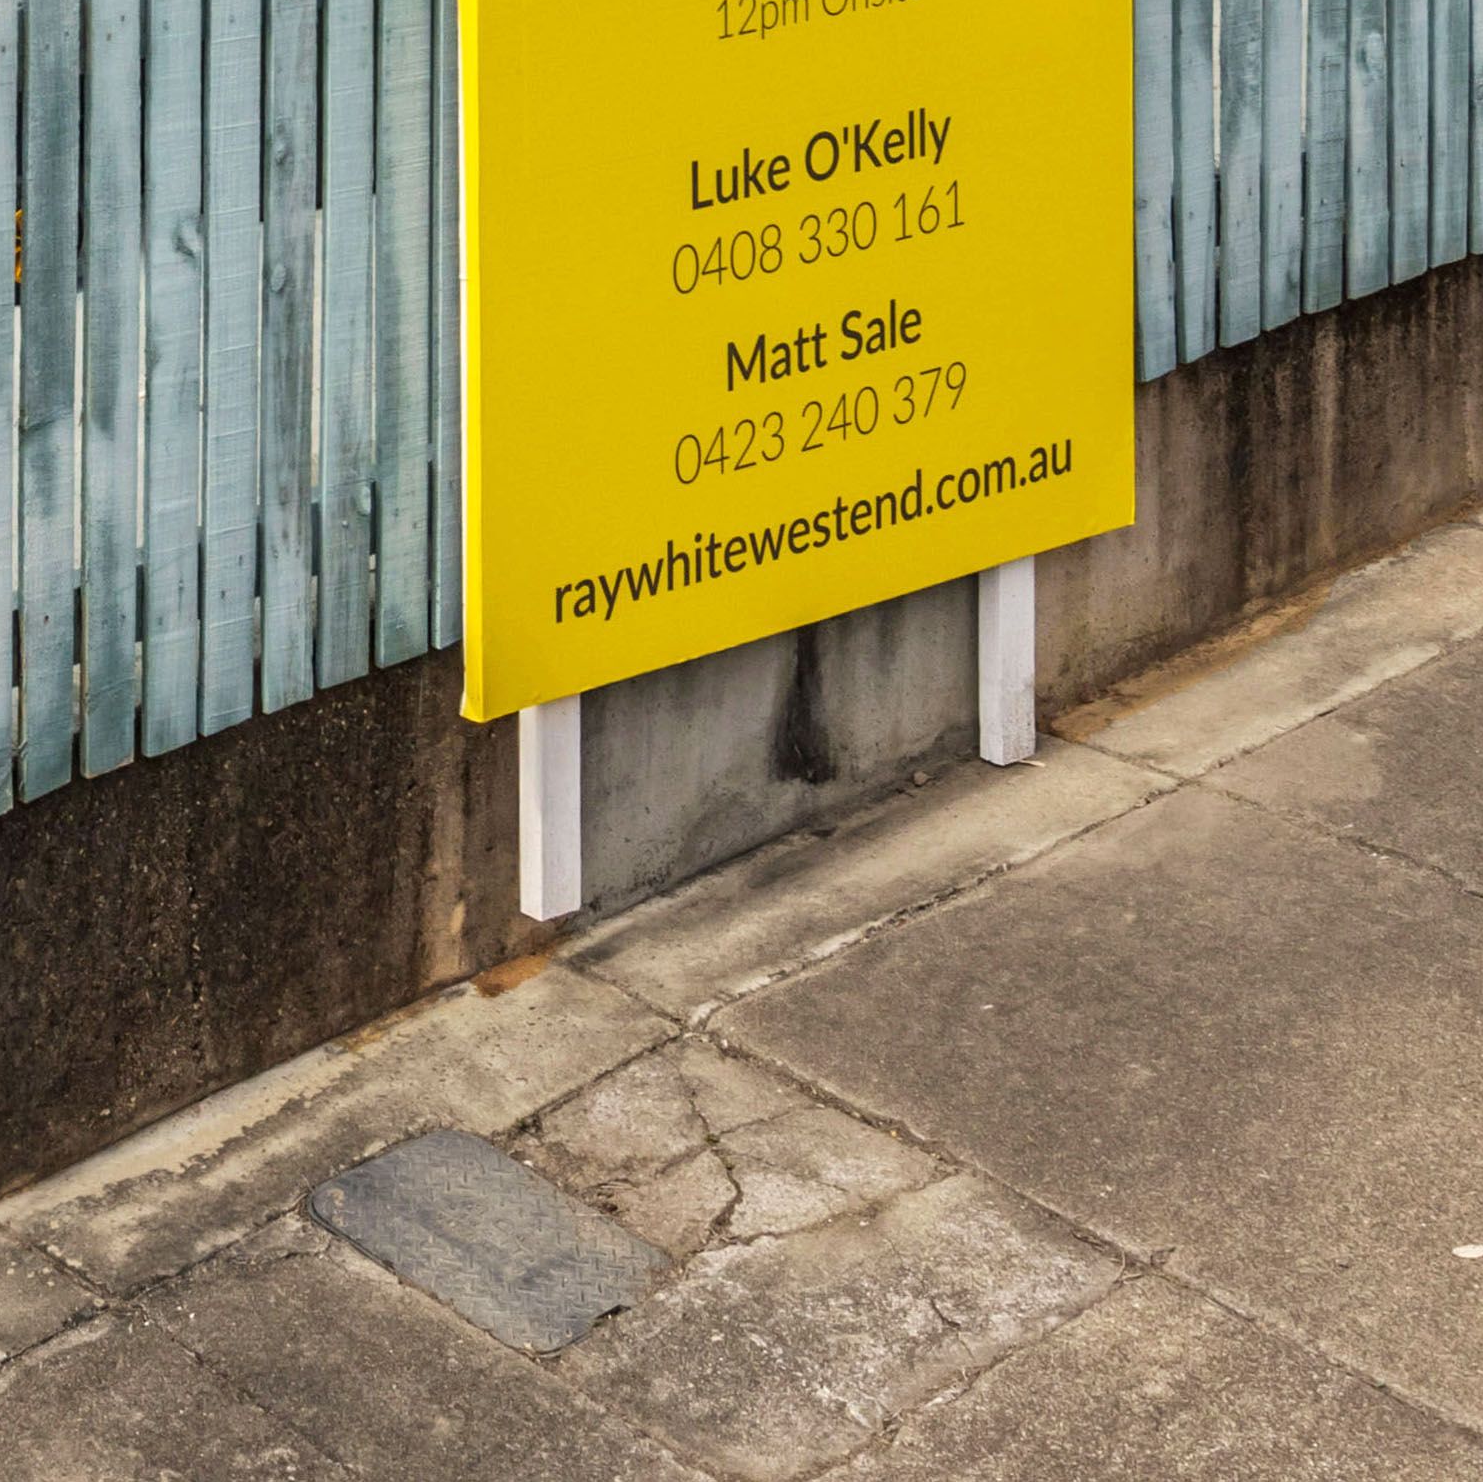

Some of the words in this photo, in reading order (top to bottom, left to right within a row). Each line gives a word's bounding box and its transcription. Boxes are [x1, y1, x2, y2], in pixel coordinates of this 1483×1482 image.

[691, 147, 792, 211] Luke
[804, 107, 952, 182] O'Kelly
[672, 223, 783, 295] 0408
[798, 201, 878, 265] 330
[893, 179, 965, 242] 161
[726, 322, 829, 393] Matt
[839, 298, 922, 361] Sale
[674, 410, 785, 485] 0423
[800, 385, 880, 453] 240
[892, 361, 967, 425] 379
[555, 438, 1072, 624] raywhitewestend.com.au
